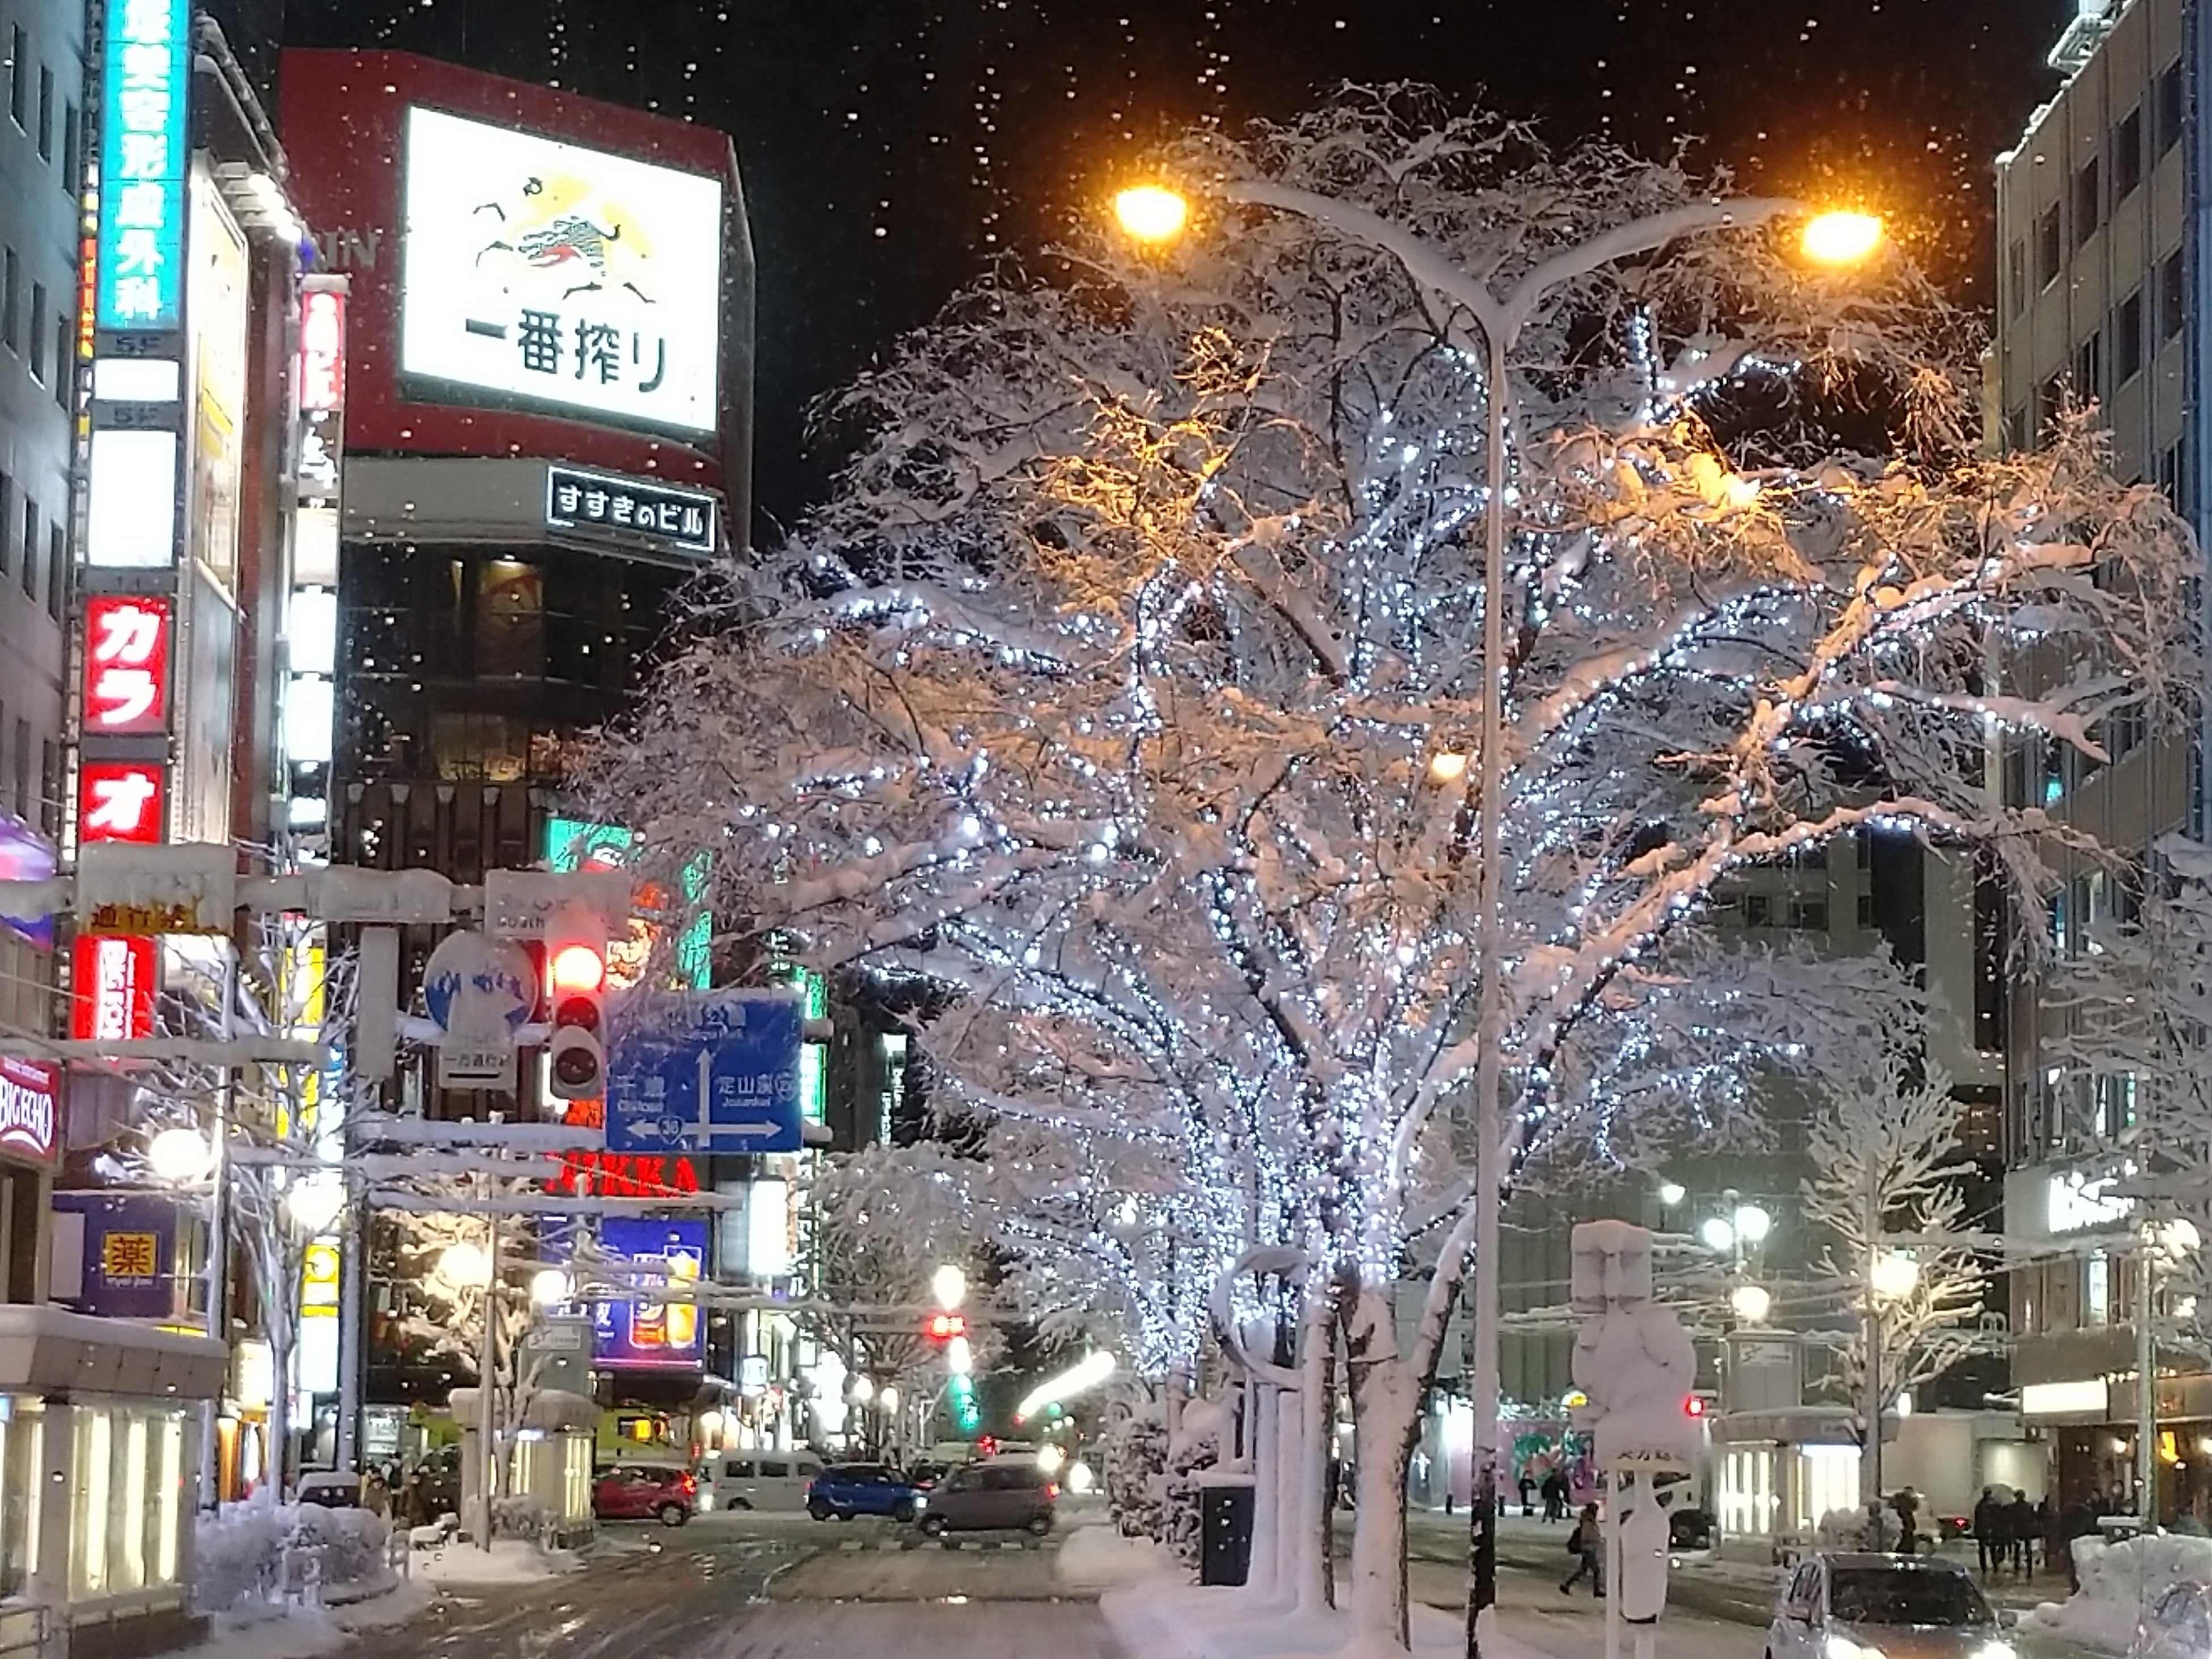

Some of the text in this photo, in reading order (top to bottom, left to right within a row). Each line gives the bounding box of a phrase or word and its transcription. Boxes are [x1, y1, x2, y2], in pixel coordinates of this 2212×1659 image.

[466, 309, 665, 392] 一番搾り
[558, 484, 704, 535] すすきのビル
[112, 1236, 150, 1274] 薬
